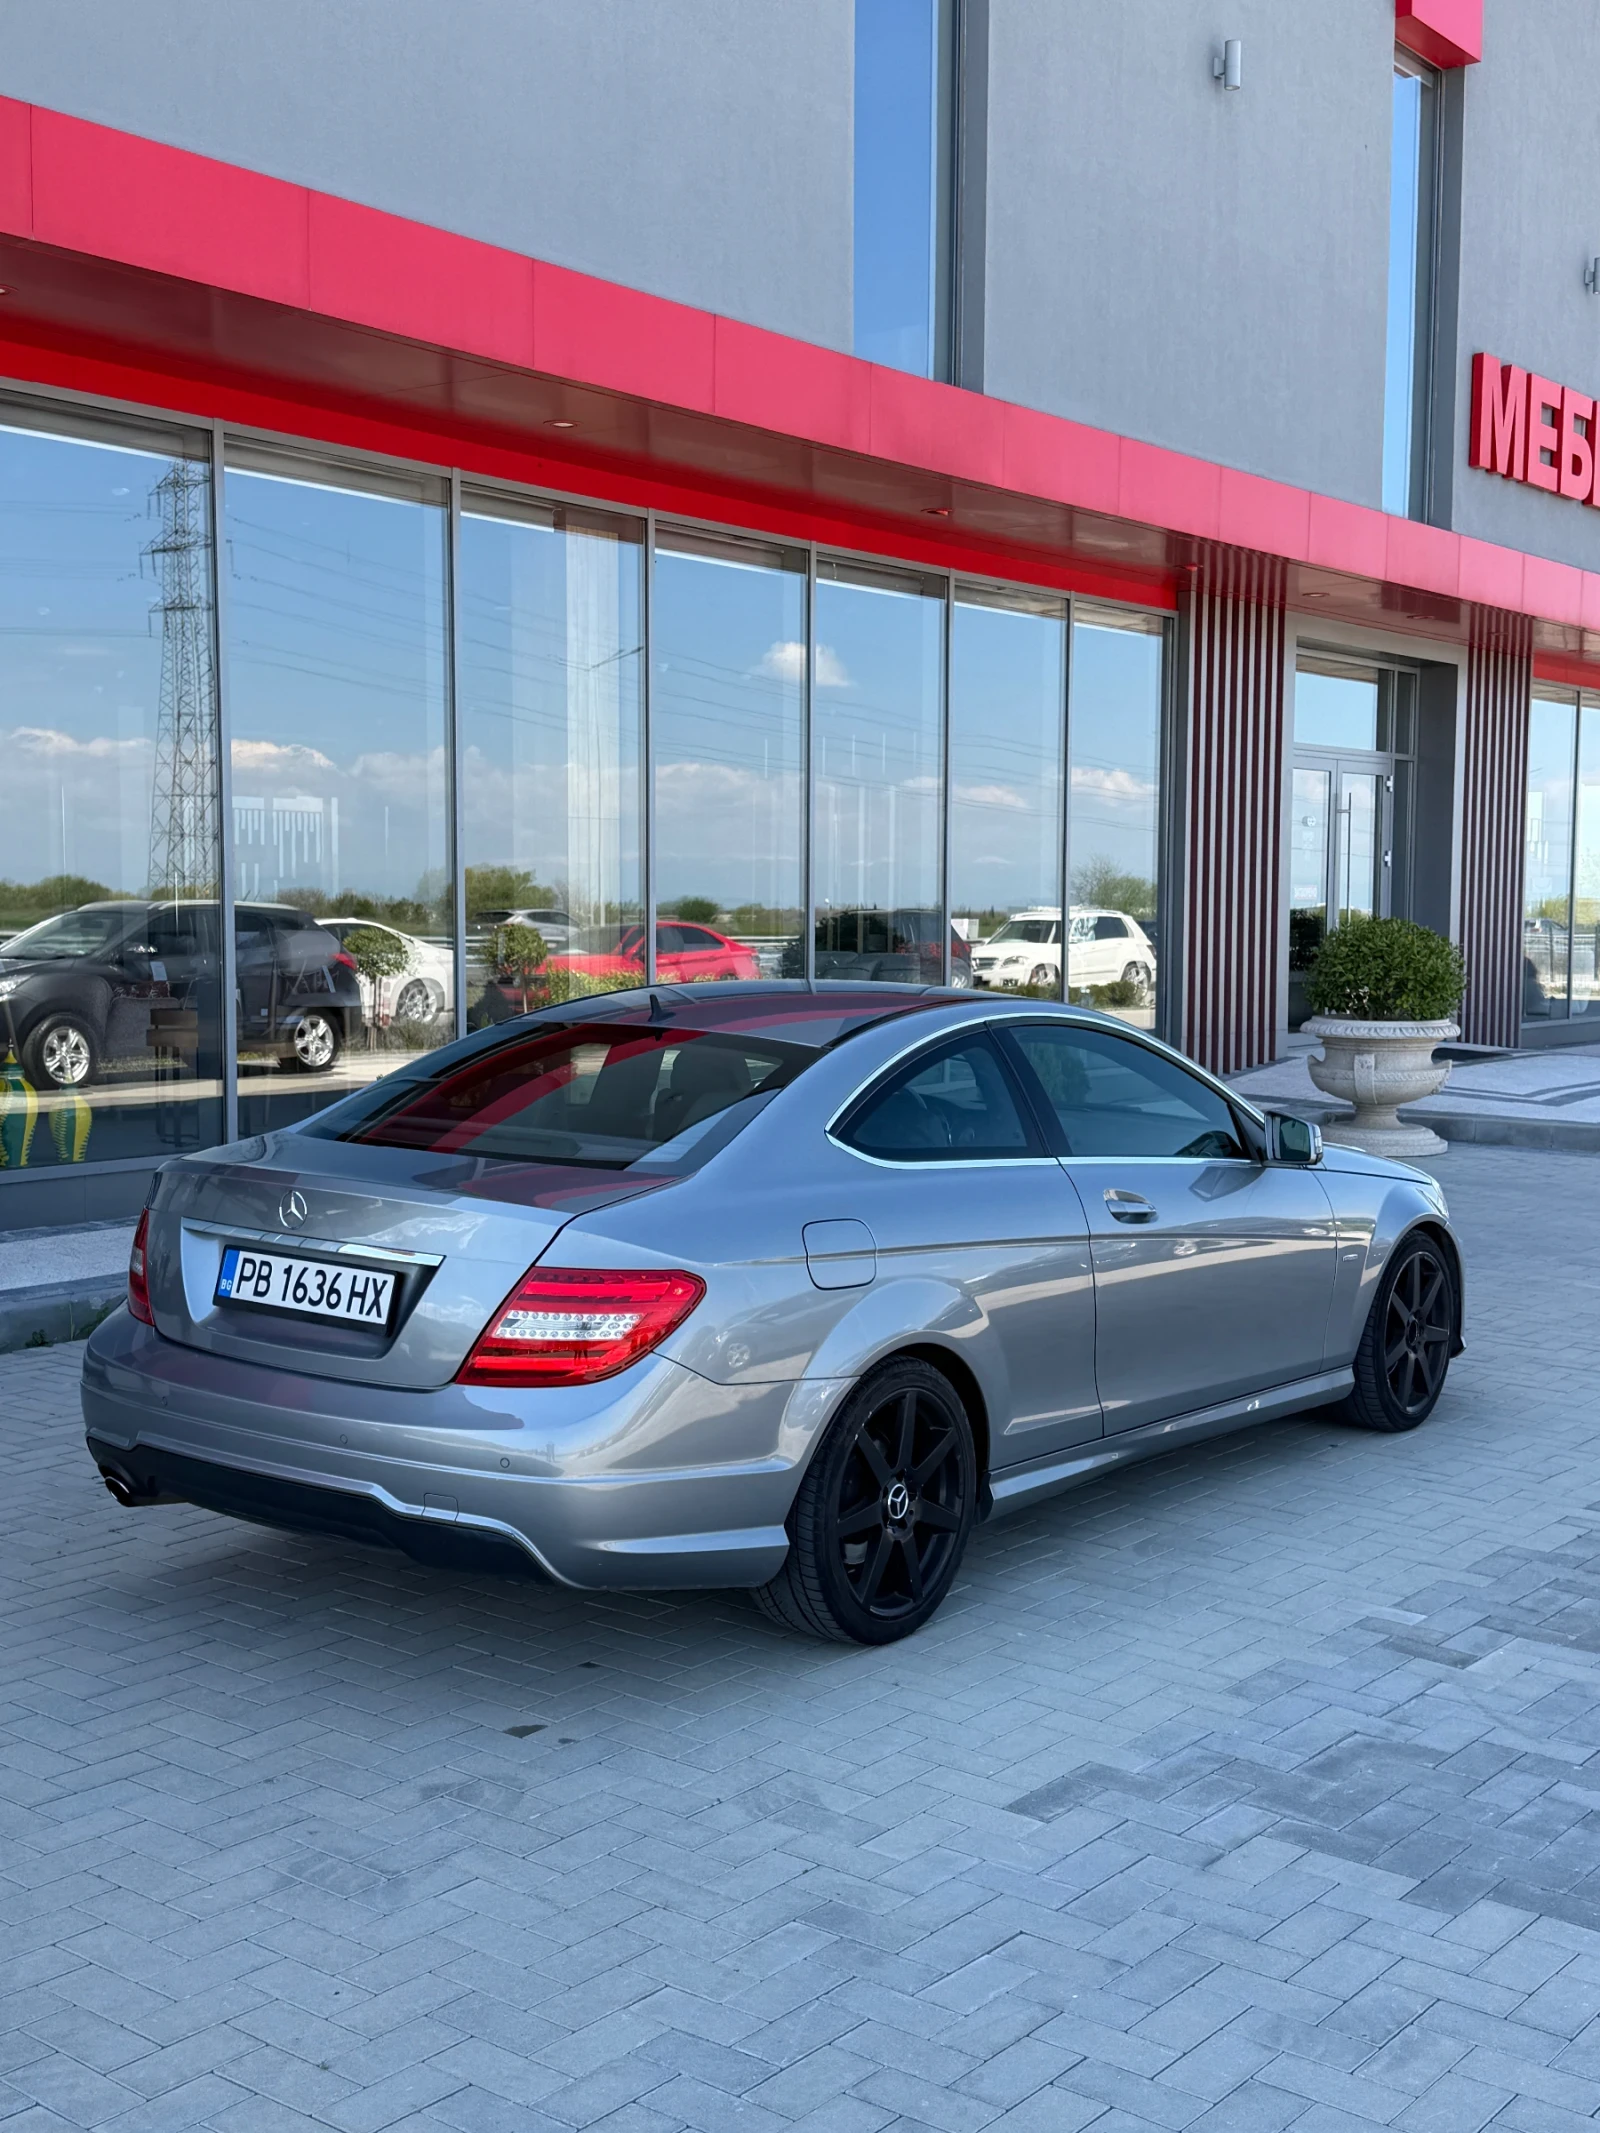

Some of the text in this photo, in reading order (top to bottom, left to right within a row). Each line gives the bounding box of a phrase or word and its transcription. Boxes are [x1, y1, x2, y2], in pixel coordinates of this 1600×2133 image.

[220, 1278, 232, 1291] BG
[236, 1257, 388, 1318] PB 1636 HX
